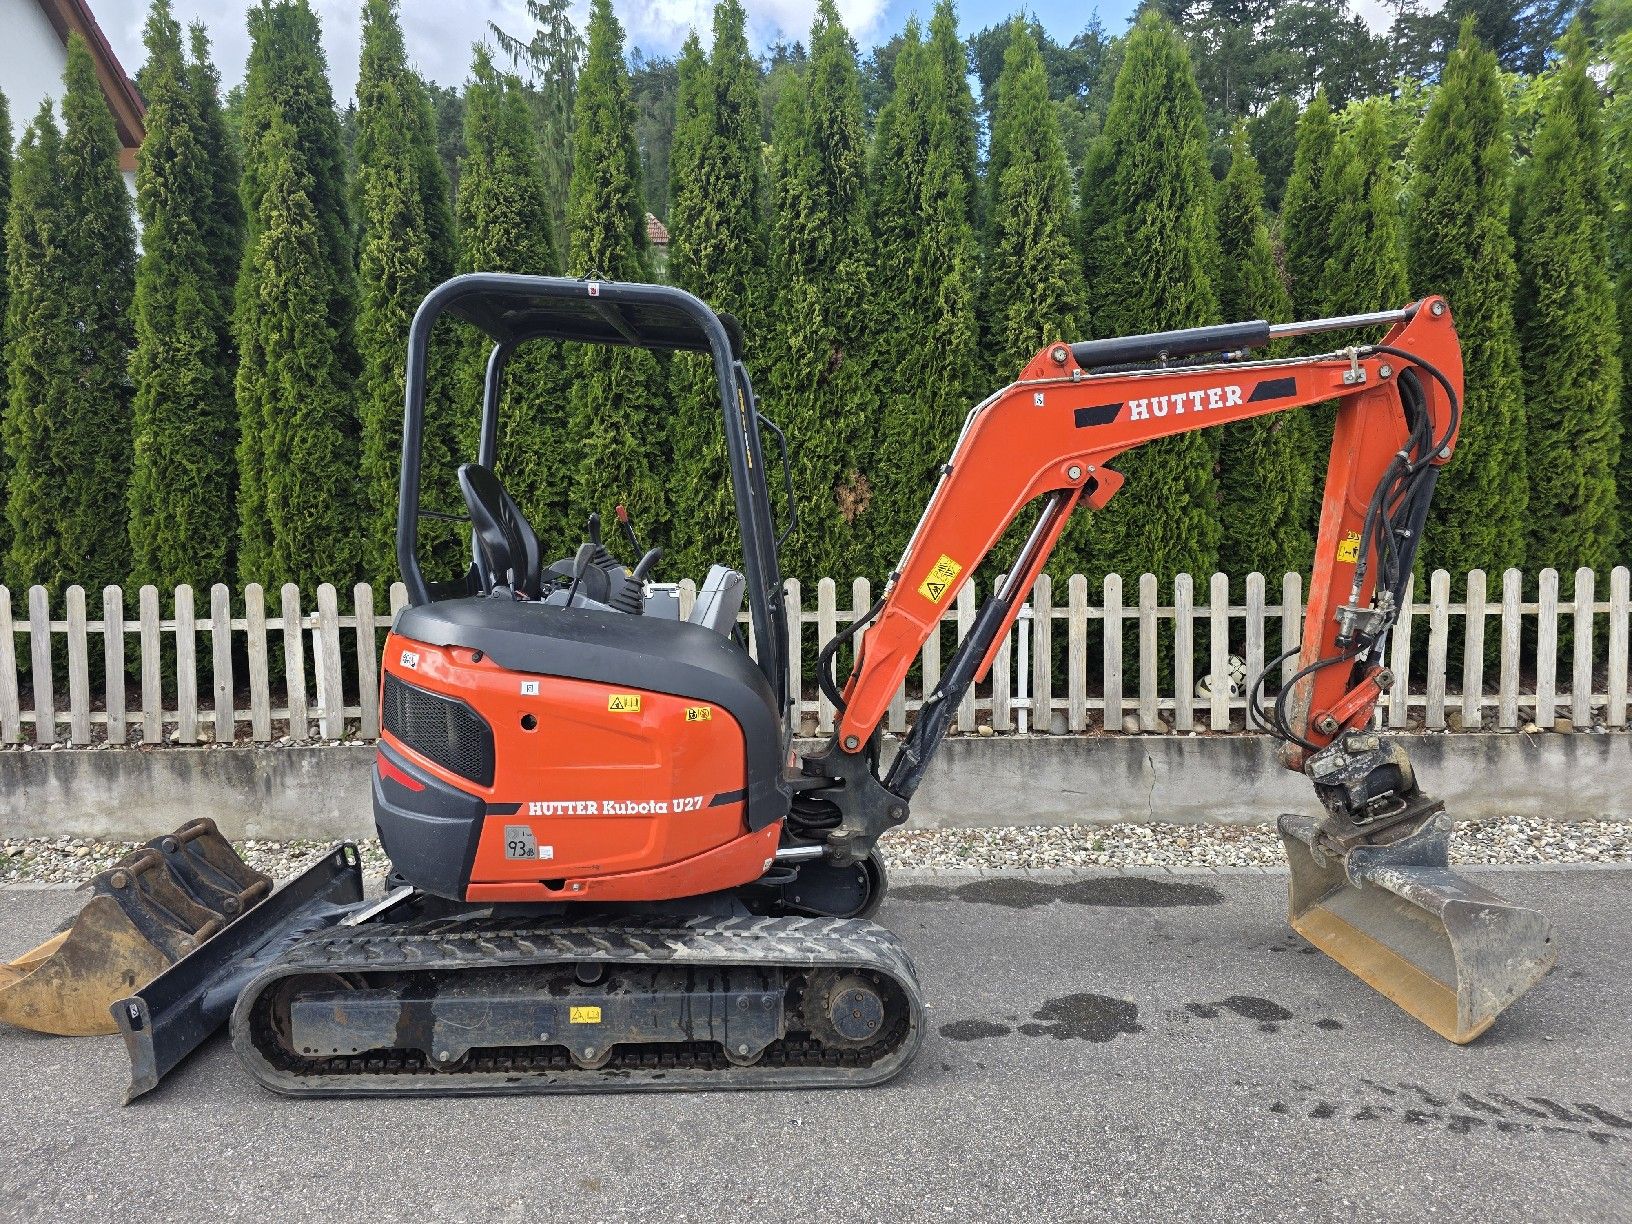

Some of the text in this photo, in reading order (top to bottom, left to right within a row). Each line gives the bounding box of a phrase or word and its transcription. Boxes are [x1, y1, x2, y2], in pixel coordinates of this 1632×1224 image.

[1128, 385, 1243, 421] HUTTER
[528, 796, 704, 816] HUTTER Kubota U27
[508, 840, 526, 857] 93
